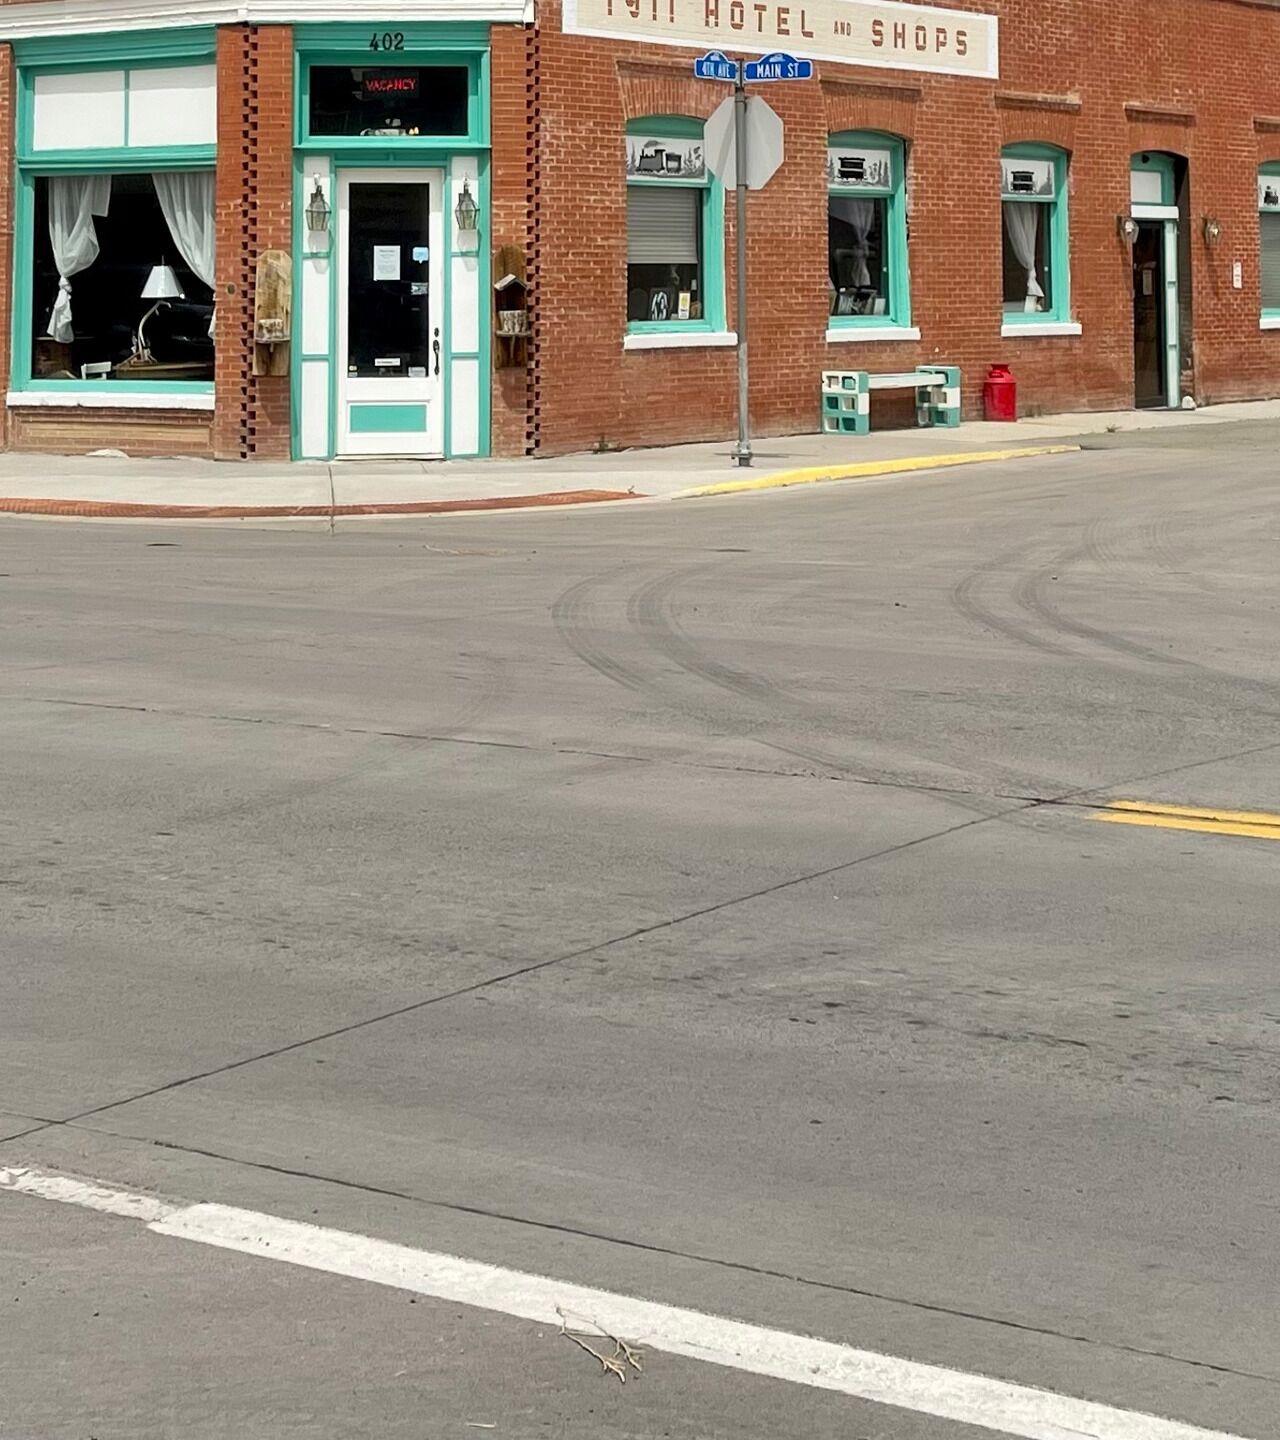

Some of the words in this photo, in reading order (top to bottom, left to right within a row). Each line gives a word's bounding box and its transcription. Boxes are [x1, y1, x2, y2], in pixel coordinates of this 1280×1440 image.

[369, 32, 405, 52] 402
[833, 20, 852, 37] AND
[871, 18, 968, 56] SHOPS
[756, 63, 781, 78] MAIN
[787, 62, 800, 78] ST
[365, 77, 416, 91] VACANCY
